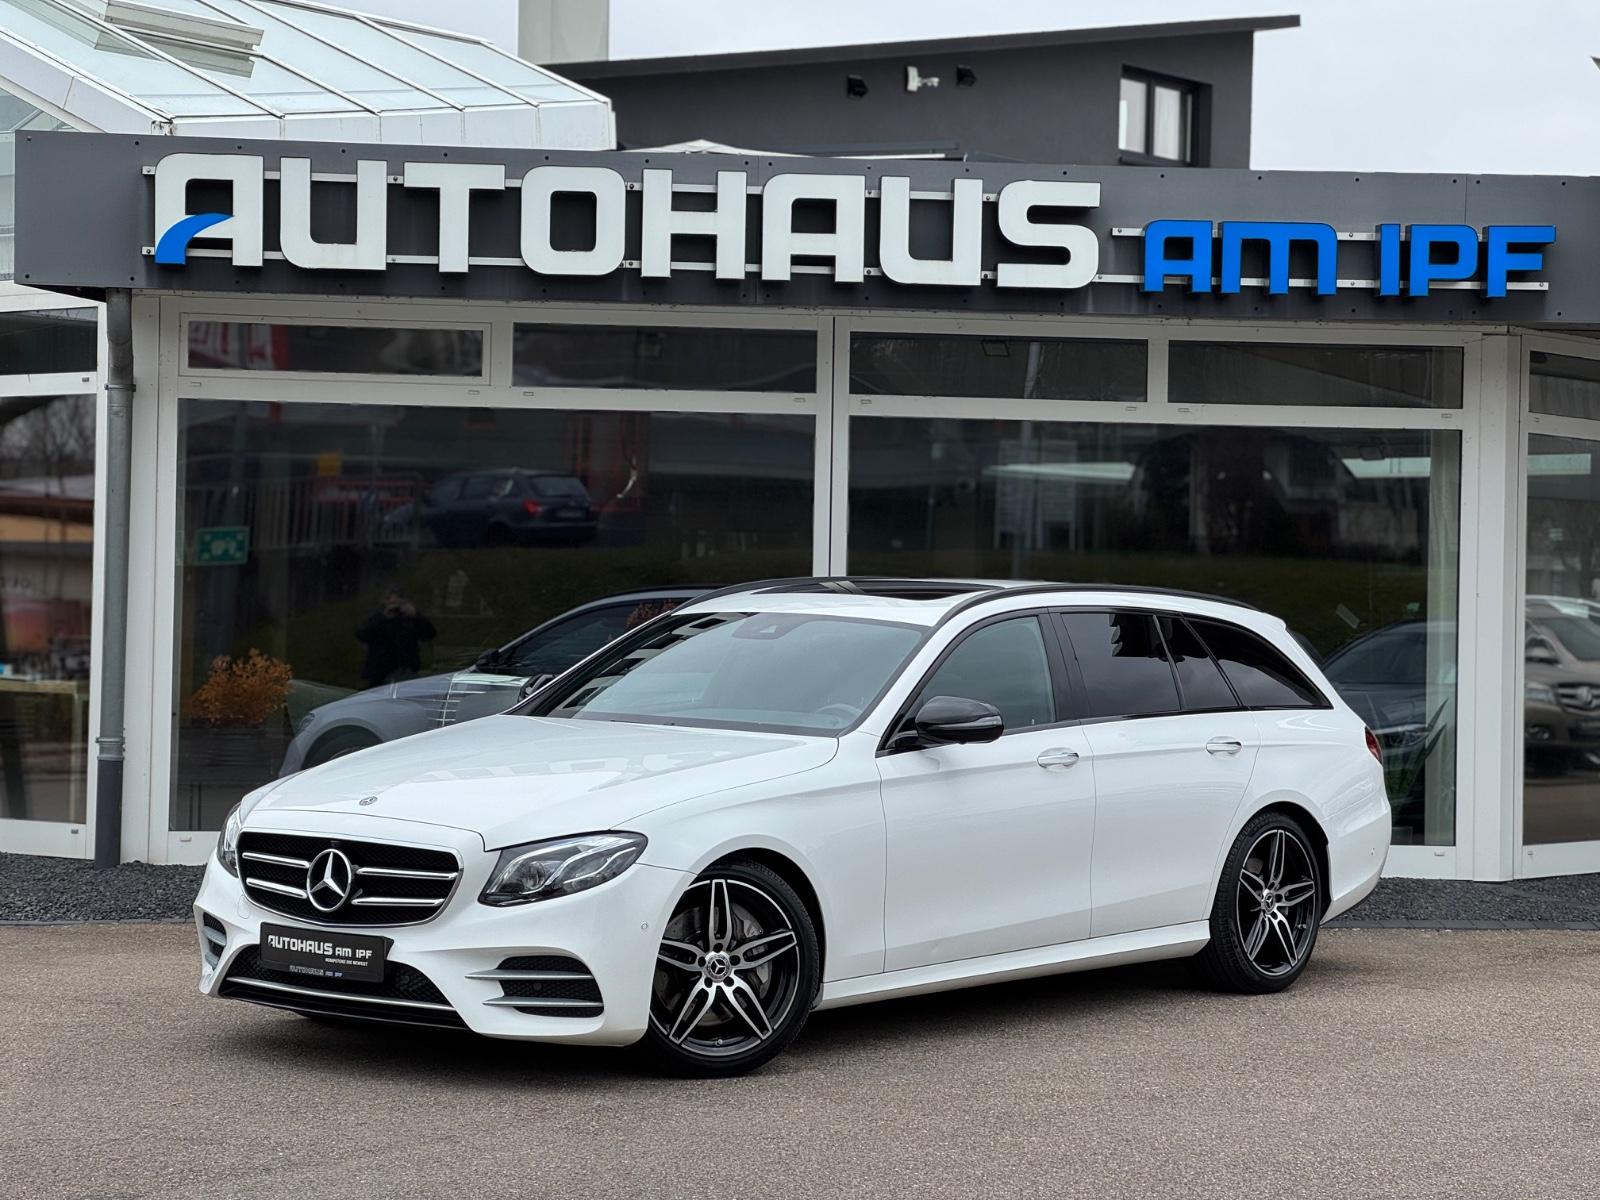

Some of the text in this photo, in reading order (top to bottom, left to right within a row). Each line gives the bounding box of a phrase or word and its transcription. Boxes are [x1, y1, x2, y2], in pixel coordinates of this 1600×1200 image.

[154, 153, 1556, 297] AUTOHAUS AM IPF
[268, 935, 373, 959] AUTOHAUS AM IPF
